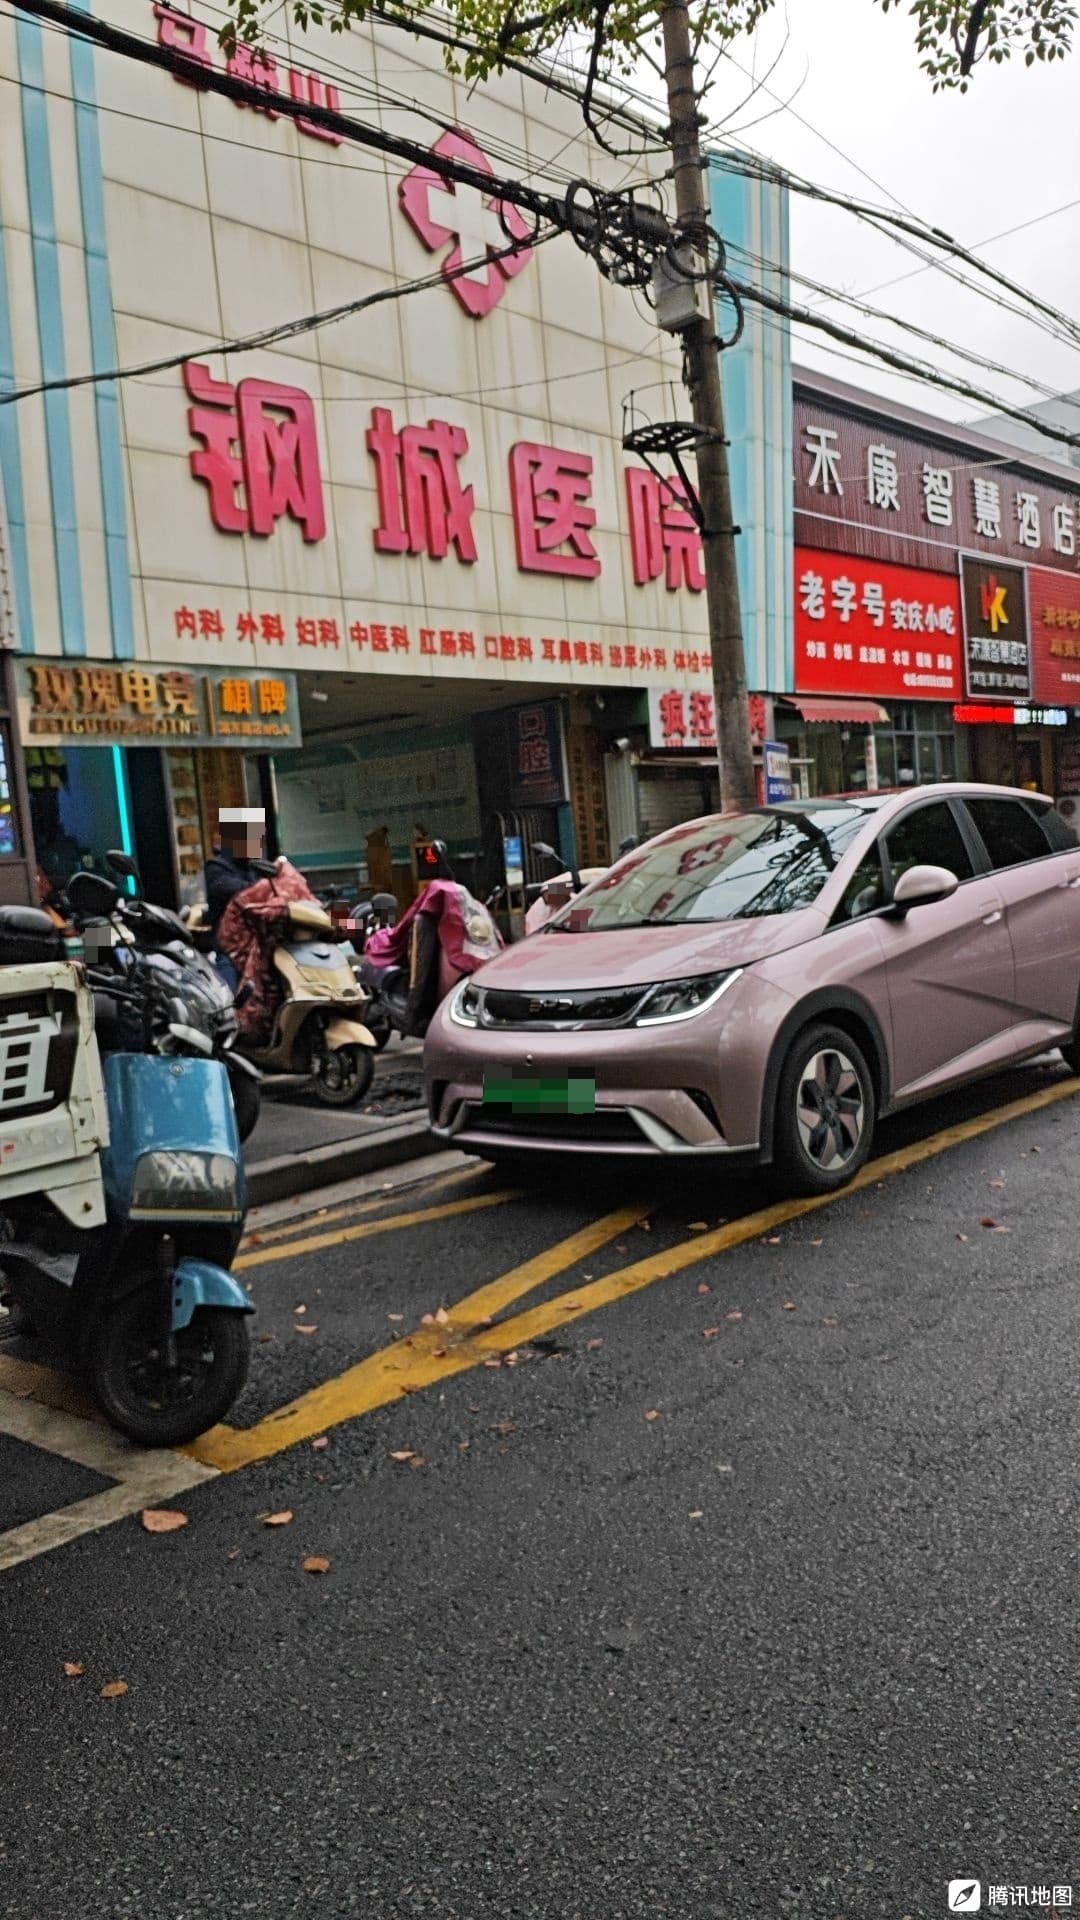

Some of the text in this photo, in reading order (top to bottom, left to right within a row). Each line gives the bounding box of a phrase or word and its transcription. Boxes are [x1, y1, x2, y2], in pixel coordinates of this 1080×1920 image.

[182, 360, 706, 592] 钢城医院
[806, 425, 1075, 555] 禾康智慧酒店
[799, 570, 956, 636] 老字号 安庆小吃
[174, 605, 224, 642] 内科
[236, 611, 285, 646] 外科
[295, 616, 340, 650] 妇科
[350, 620, 410, 654] 中医科
[419, 628, 476, 659] 肛肠科
[484, 634, 533, 663] 口腔科
[541, 638, 604, 668] 耳鼻喉科
[609, 644, 667, 672] 泌尿外科
[29, 665, 287, 716] 玫瑰电竞 棋牌
